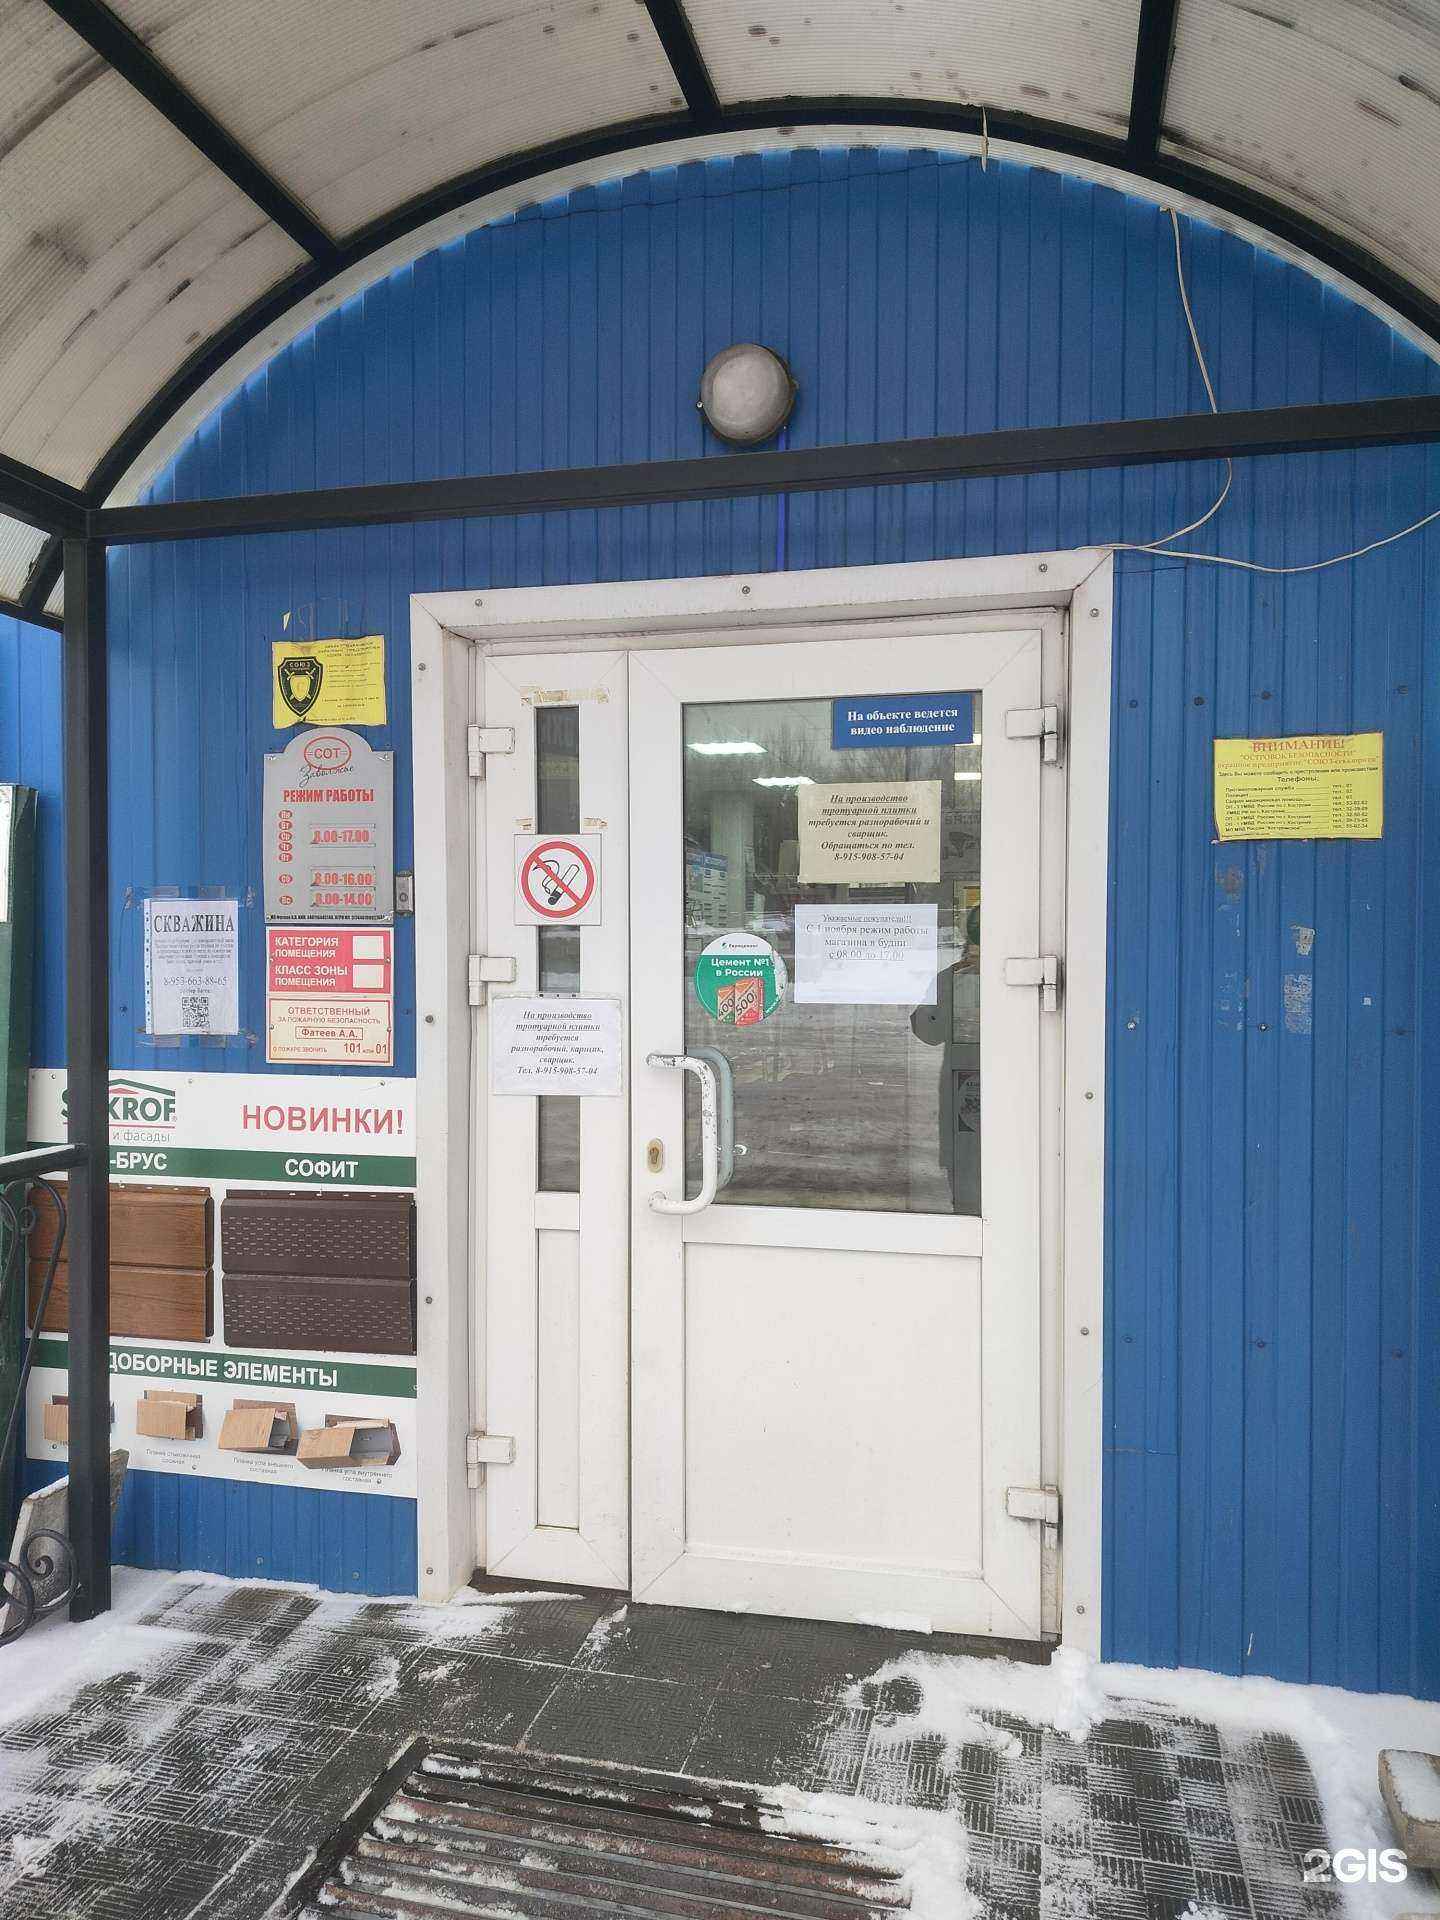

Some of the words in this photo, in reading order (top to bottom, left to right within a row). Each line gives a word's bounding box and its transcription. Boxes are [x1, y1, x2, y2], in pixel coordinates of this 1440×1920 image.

[848, 711, 864, 721] На
[867, 710, 911, 722] объекте
[914, 708, 958, 720] ведется
[851, 726, 883, 736] видео
[886, 723, 955, 735] наблюдение
[283, 790, 322, 803] РЕЖИМ
[327, 789, 374, 802] РАБОТЫ
[830, 795, 843, 803] На
[846, 793, 908, 804] производство
[822, 807, 878, 816] тротуарной
[881, 807, 917, 815] плитки
[808, 819, 856, 828] требуется
[858, 818, 921, 827] разнорабочий
[847, 831, 889, 839] сварщик.
[821, 842, 879, 851] Обращаться
[834, 853, 905, 861] 8-915-908-57-04
[154, 914, 235, 933] СКВАЖИНА
[824, 925, 858, 935] ноября
[275, 937, 339, 947] КАТЕГОРИЯ
[275, 950, 336, 959] ПОМЕЩЕНИЯ
[711, 958, 752, 967] Цемент
[754, 958, 770, 967] №1
[275, 965, 311, 976] КЛАСС
[315, 966, 348, 976] ЗОНЫ
[725, 969, 764, 977] России
[275, 978, 336, 987] ПОМЕЩЕНИЯ
[288, 1006, 370, 1016] ОТВЕТСТВЕННЫЙ
[523, 1011, 536, 1019] На
[538, 1012, 592, 1021] производство
[515, 1023, 567, 1032] тротуарной
[301, 1028, 336, 1038] Фатеев
[339, 1030, 358, 1038] А.А.
[343, 1043, 361, 1054] 101
[375, 1044, 387, 1054] 01
[242, 1104, 404, 1135] НОВИНКИ!
[112, 1132, 120, 1140] и
[123, 1129, 170, 1143] фасады
[285, 1158, 359, 1180] СОФИТ
[223, 1361, 338, 1388] ЭЛЕМЕНТЫ
